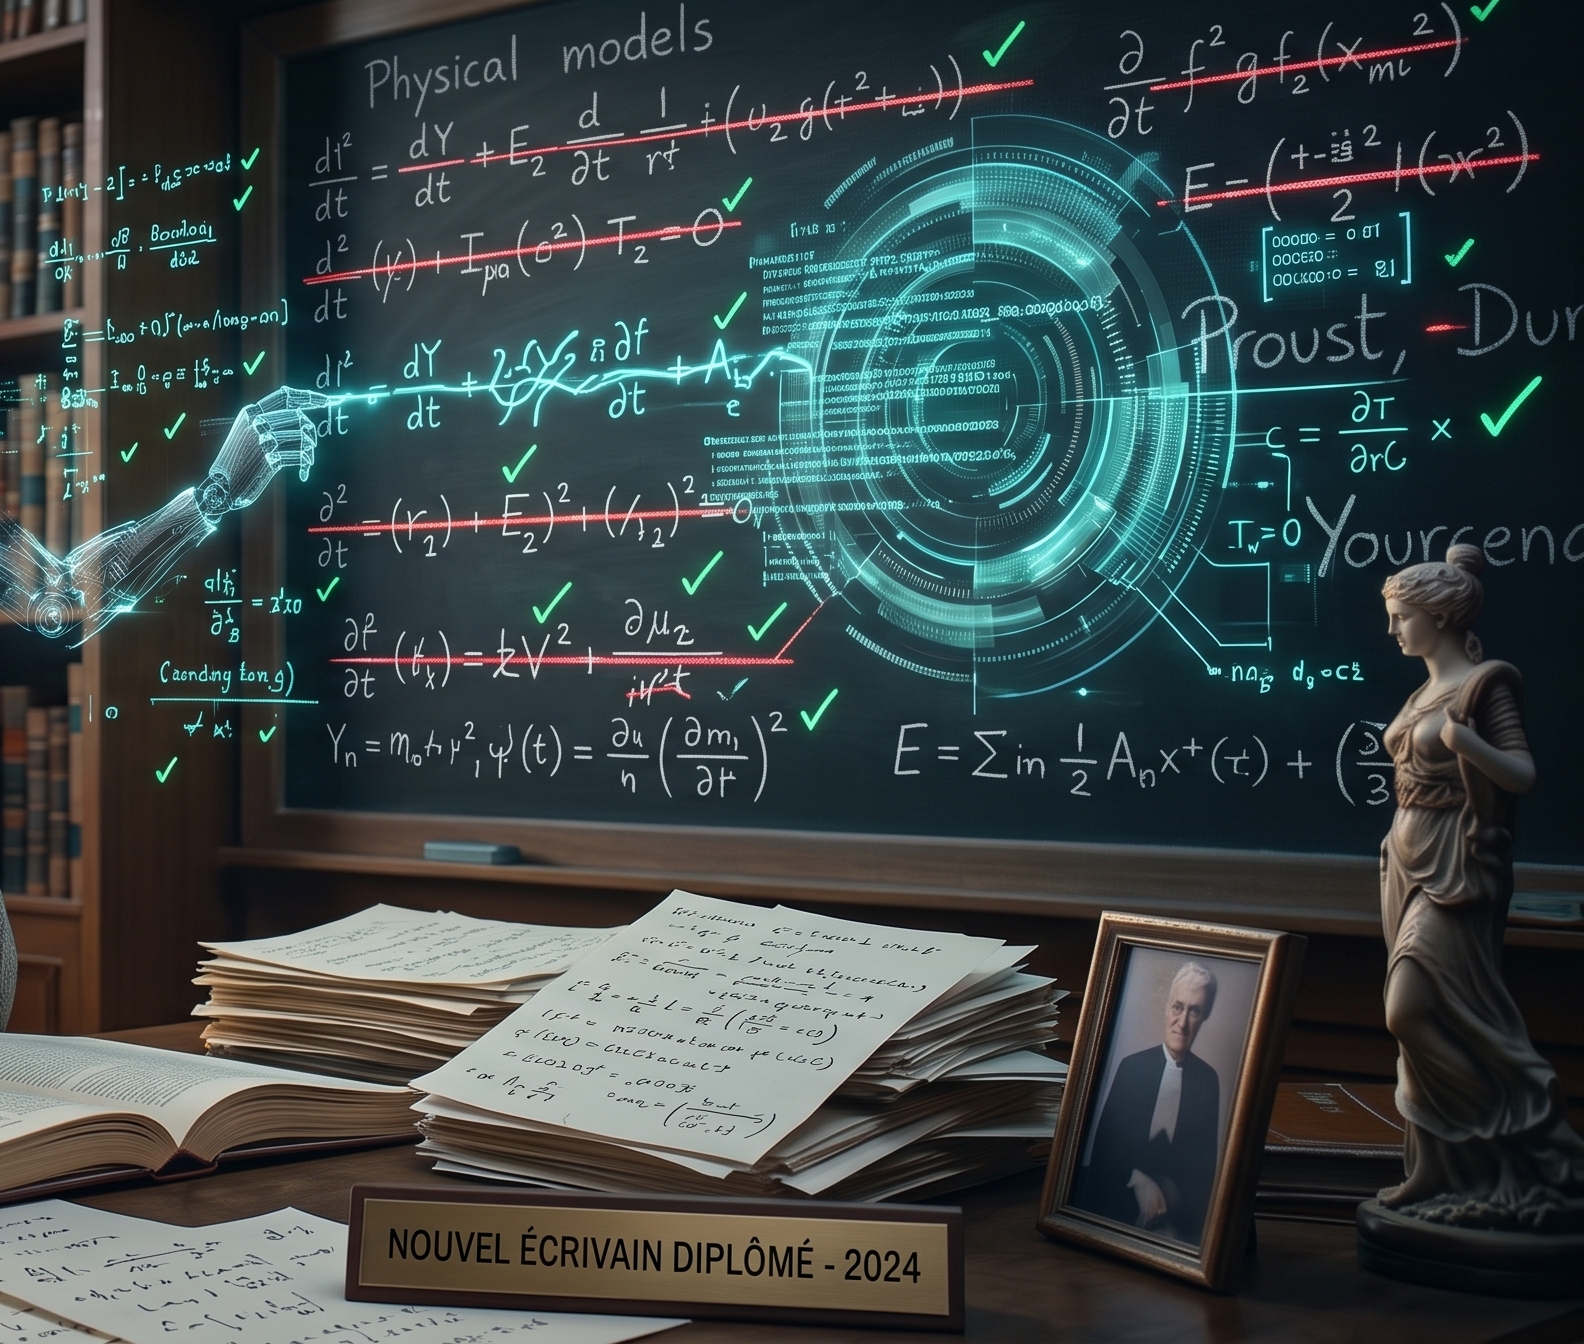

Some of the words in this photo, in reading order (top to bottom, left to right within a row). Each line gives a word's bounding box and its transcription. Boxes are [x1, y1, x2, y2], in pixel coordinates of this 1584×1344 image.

[365, 34, 517, 117] Physical
[563, 3, 714, 73] models
[1181, 292, 1407, 375] Proust,
[388, 1227, 511, 1266] NOUVEL
[519, 1225, 663, 1273] ÉCRIVAIN
[672, 1236, 814, 1280] DIPLÔMÉ
[843, 1247, 922, 1285] 2024
